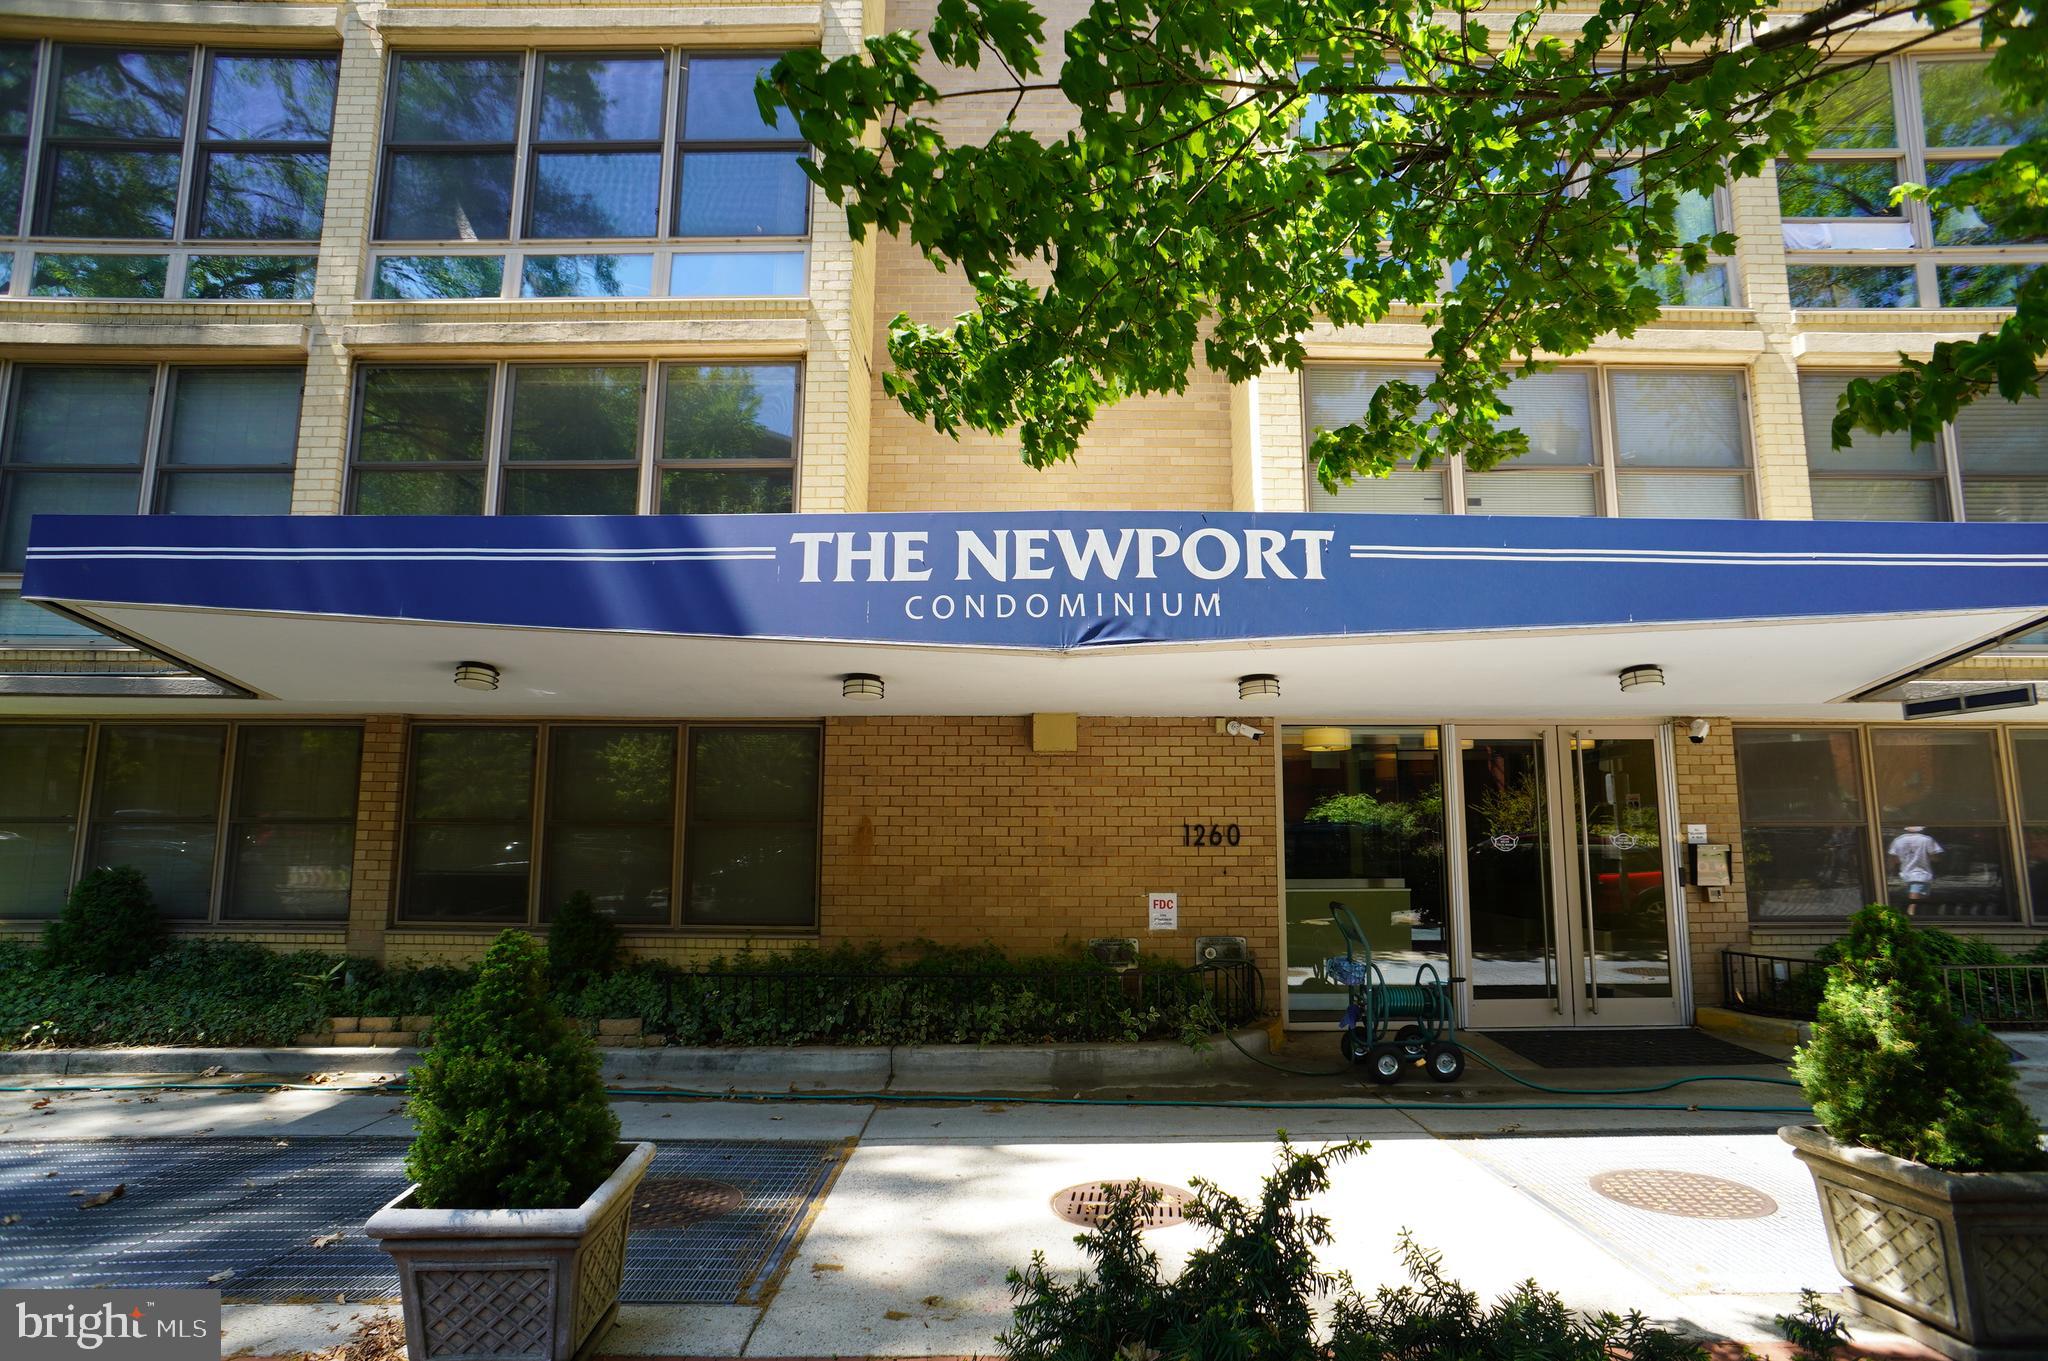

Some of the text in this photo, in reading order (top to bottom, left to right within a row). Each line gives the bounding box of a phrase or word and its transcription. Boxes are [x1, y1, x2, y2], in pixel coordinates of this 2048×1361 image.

[789, 528, 1334, 583] THE NEWPORT
[905, 593, 1222, 620] CONDOMINIUM
[1184, 824, 1241, 847] 1260
[1153, 899, 1174, 909] FDC
